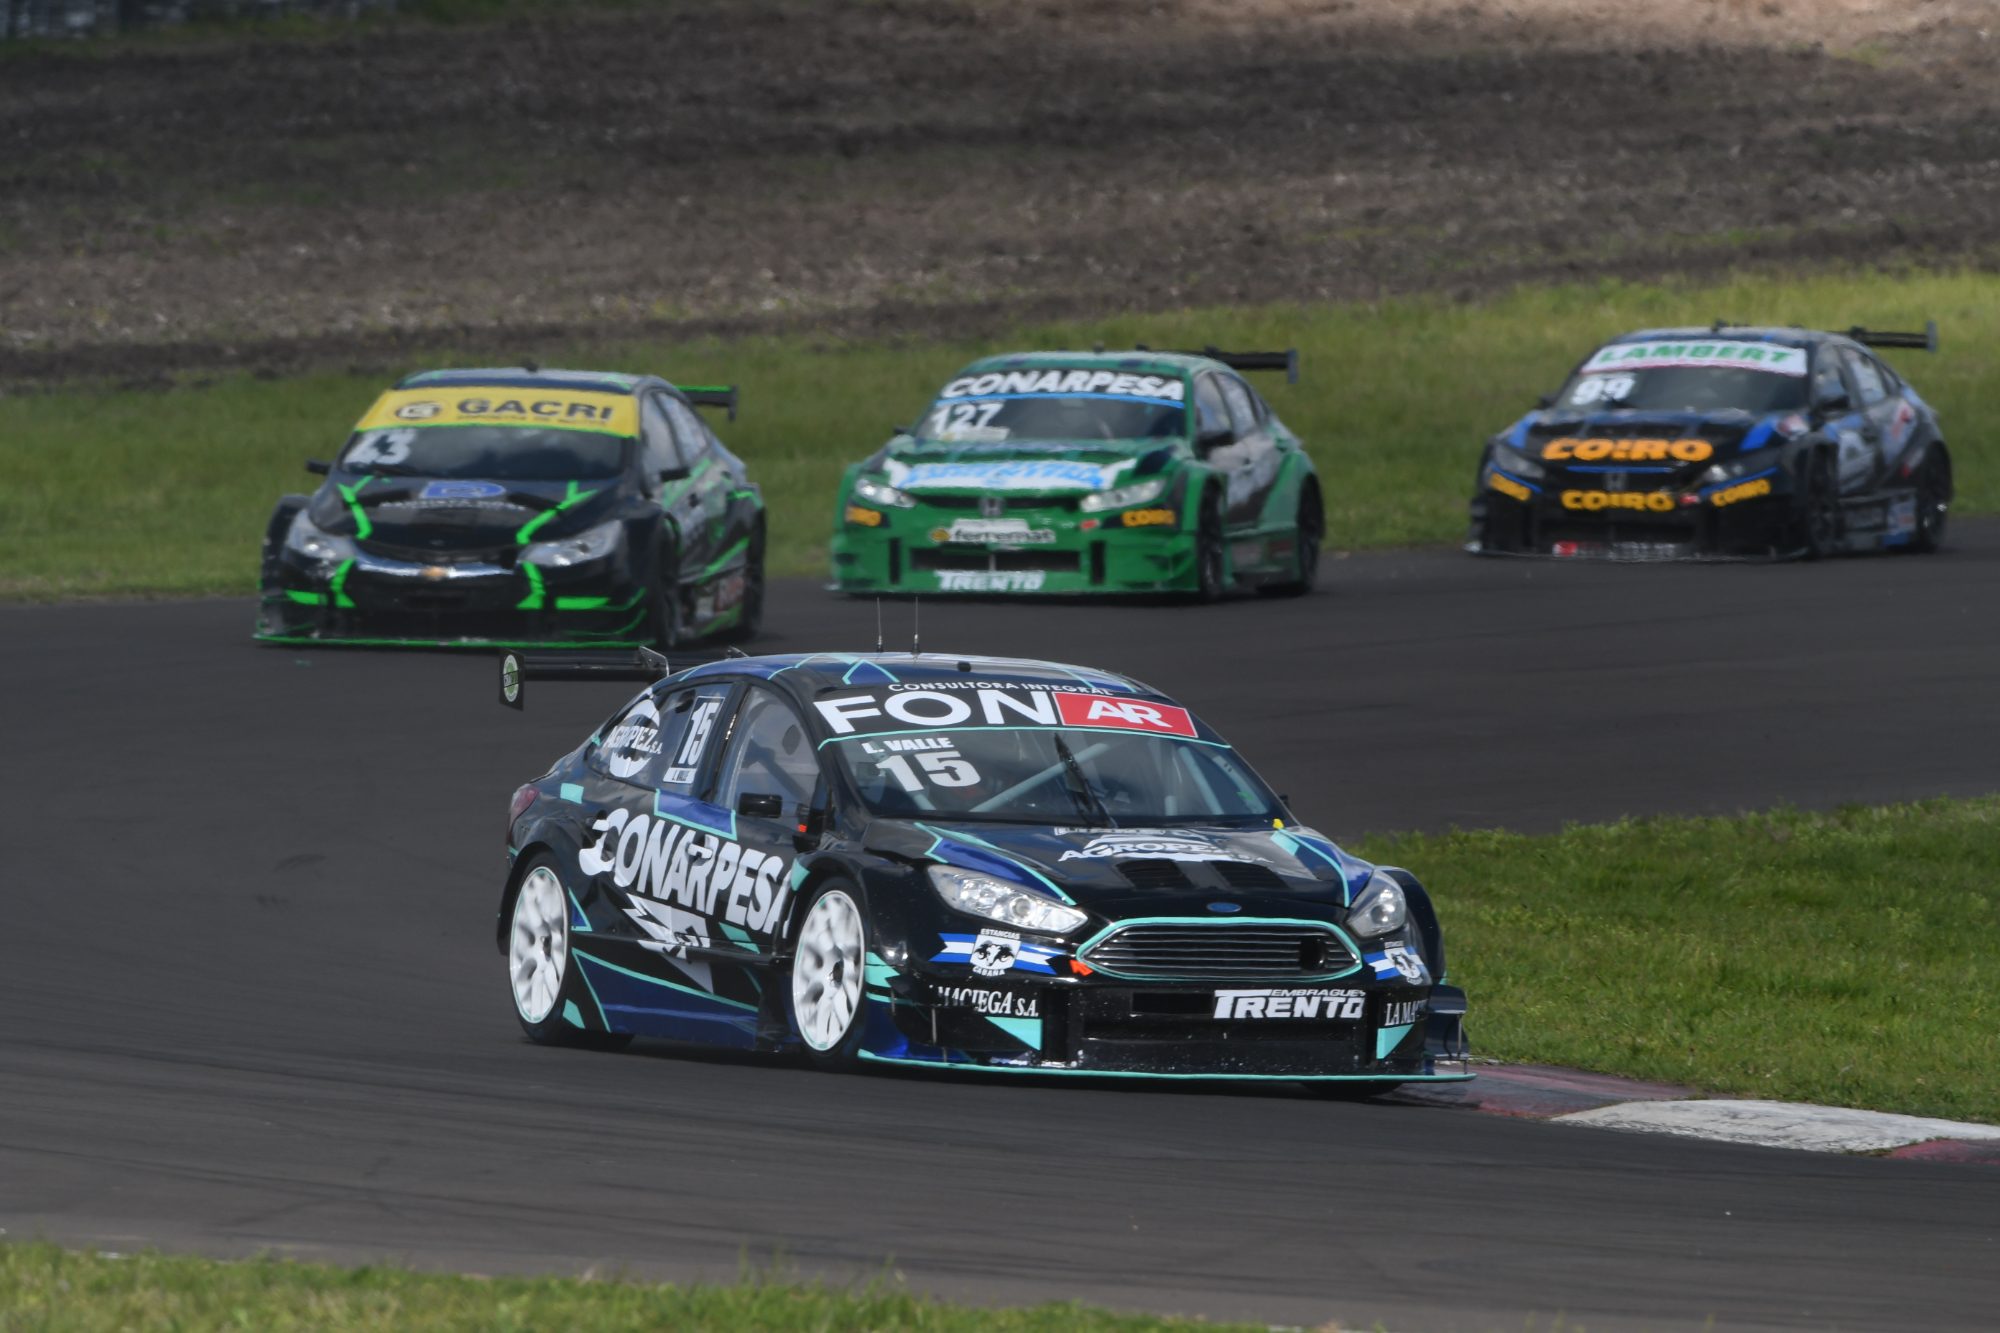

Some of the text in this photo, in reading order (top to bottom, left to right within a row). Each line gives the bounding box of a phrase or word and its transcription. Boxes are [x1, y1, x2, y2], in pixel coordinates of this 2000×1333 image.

[941, 370, 1184, 400] CONARPESA
[457, 399, 613, 420] GACRI
[931, 402, 1003, 435] 127
[1541, 438, 1713, 461] COIRO
[1560, 489, 1675, 511] COIRO
[888, 682, 1113, 696] CONSULTORA INTEGRAL
[813, 689, 1170, 734] FON AR
[678, 702, 720, 765] 15
[883, 737, 955, 752] VALLE
[875, 751, 981, 792] 15
[579, 808, 792, 939] CONARPESA
[1213, 990, 1366, 1019] TRENTO
